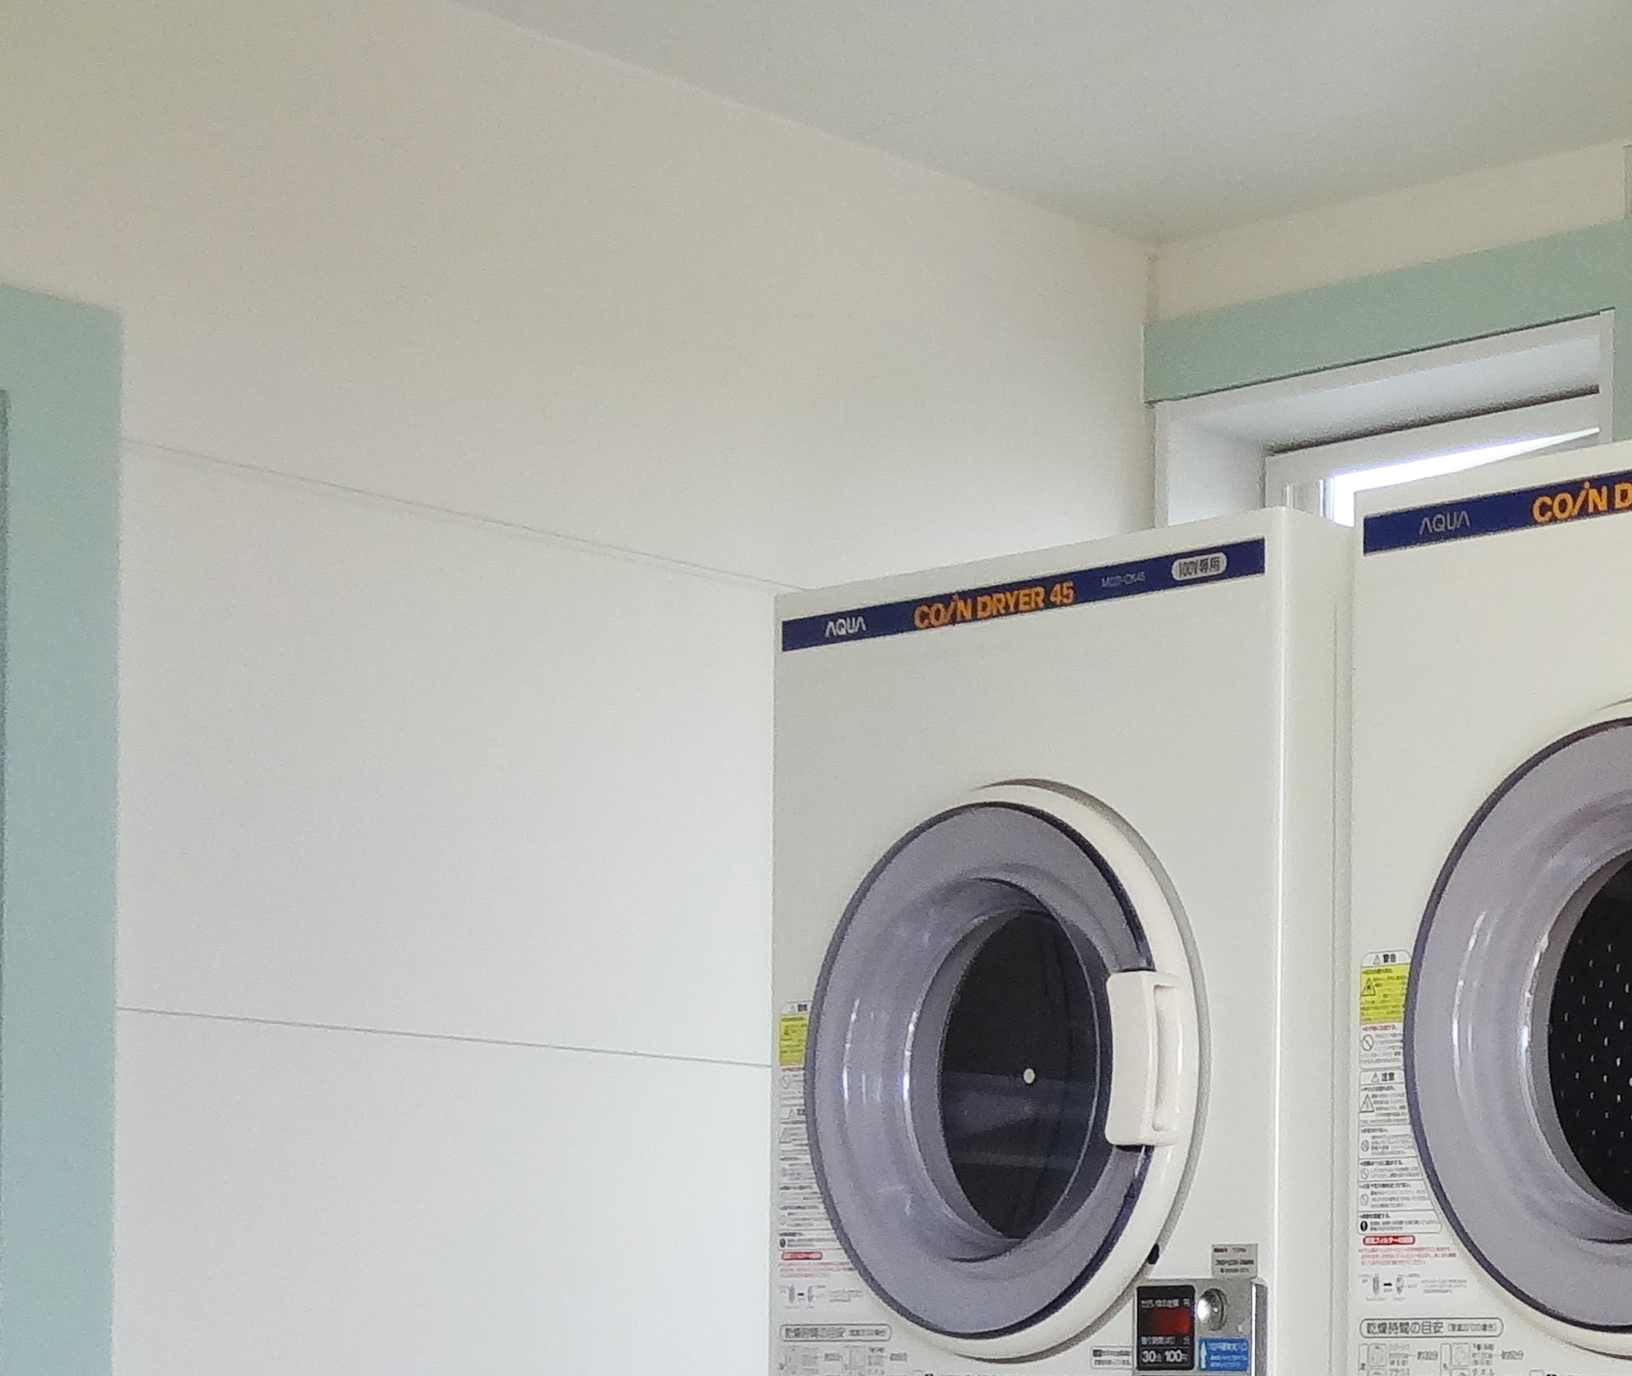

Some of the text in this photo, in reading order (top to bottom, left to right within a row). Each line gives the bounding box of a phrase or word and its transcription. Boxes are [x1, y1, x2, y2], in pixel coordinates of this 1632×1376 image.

[1420, 510, 1470, 535] AQUA
[825, 615, 866, 637] AQUA
[977, 584, 1045, 618] DRYER
[1051, 581, 1073, 605] 45
